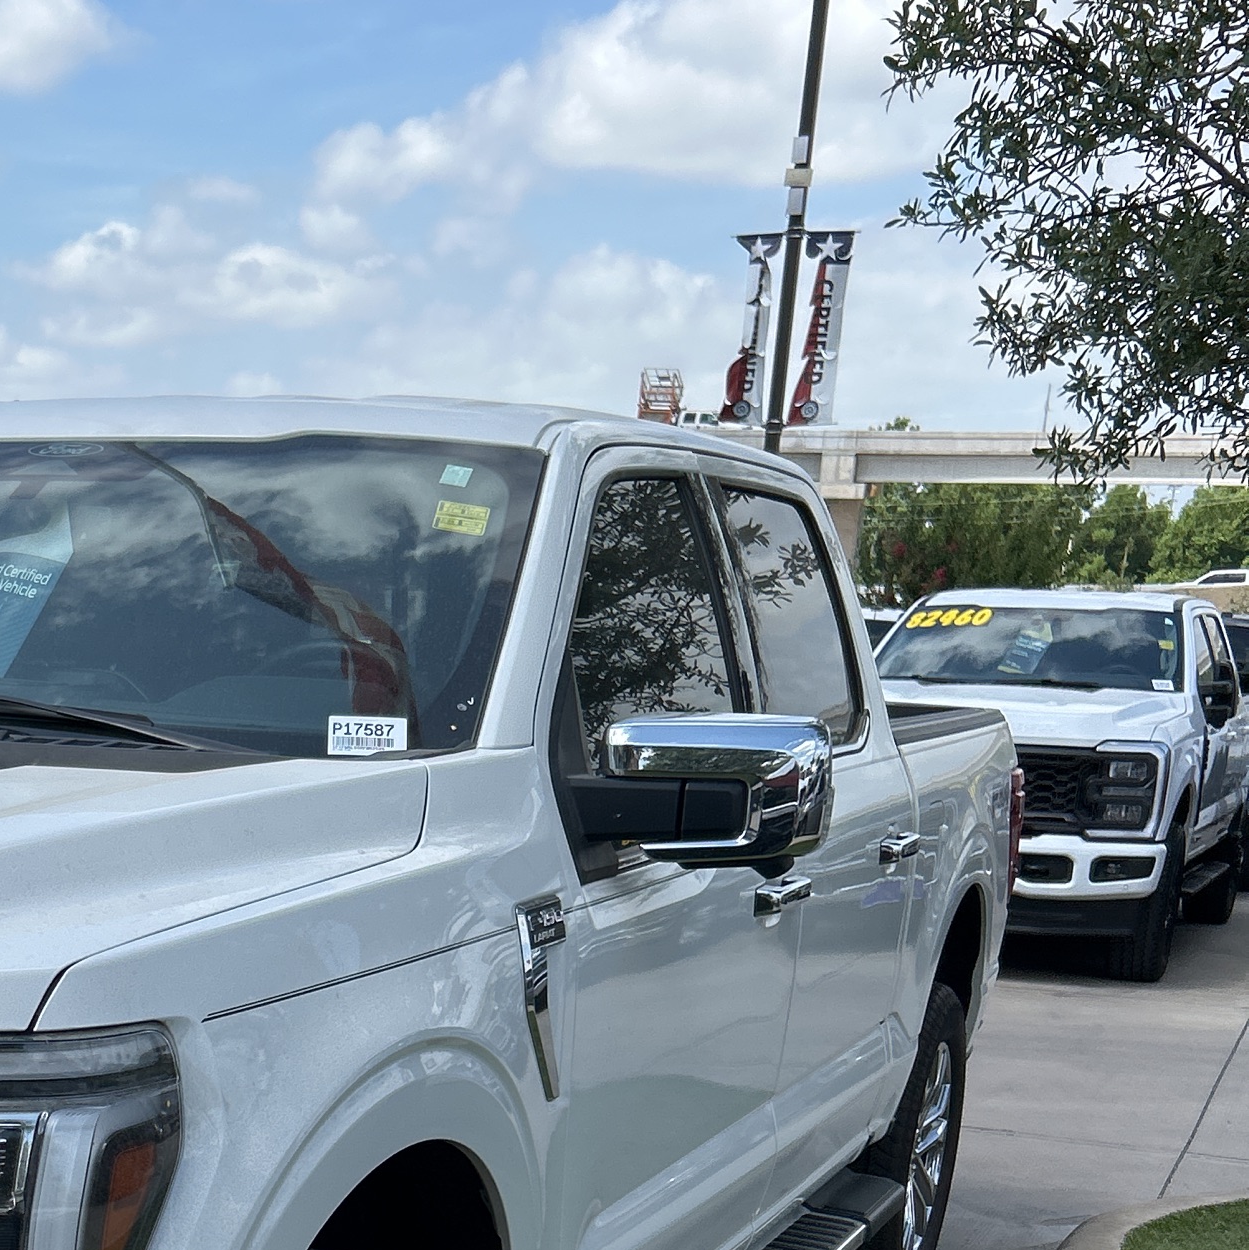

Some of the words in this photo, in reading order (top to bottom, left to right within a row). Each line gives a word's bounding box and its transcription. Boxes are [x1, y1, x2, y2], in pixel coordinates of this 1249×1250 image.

[3, 564, 52, 585] Certified
[905, 608, 993, 629] 82460
[332, 722, 395, 737] P17587
